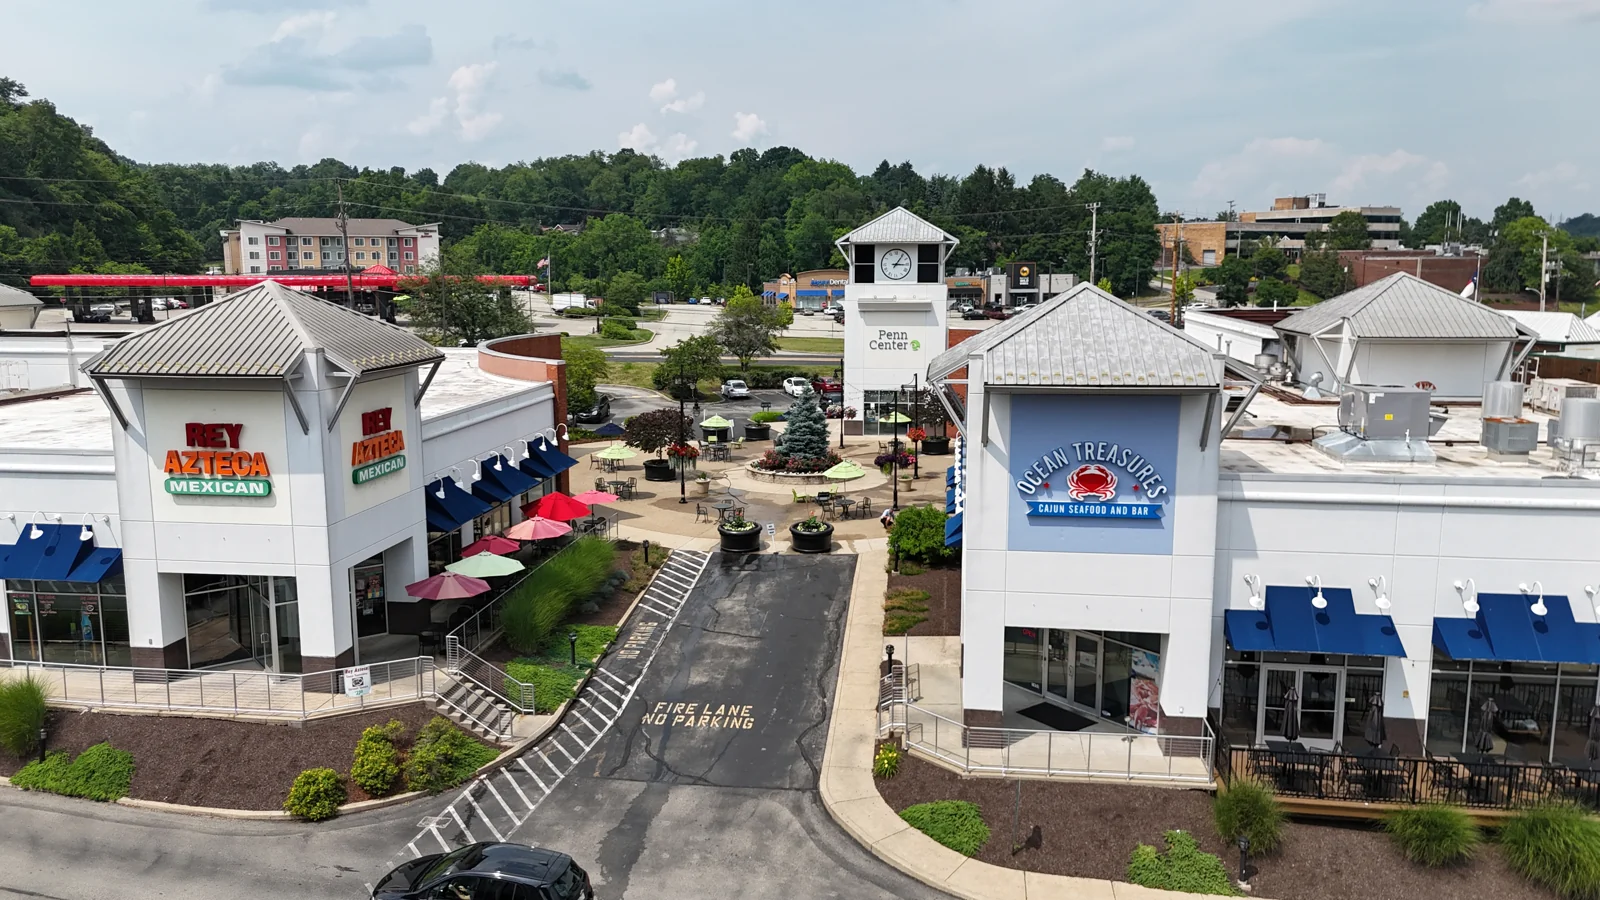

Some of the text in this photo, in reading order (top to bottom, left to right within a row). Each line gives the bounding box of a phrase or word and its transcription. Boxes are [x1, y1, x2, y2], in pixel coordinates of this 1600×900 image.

[878, 330, 908, 340] Penn
[869, 340, 908, 350] Center
[362, 406, 392, 436] REY
[185, 422, 244, 449] REY
[351, 429, 405, 466] AZTECA
[163, 449, 270, 477] AZTECA
[358, 456, 404, 482] MEXICAN
[1016, 441, 1168, 498] OCEAN TREASURES
[169, 480, 265, 494] MEXICAN
[1038, 504, 1149, 516] CAJUN SEAFOOD AND BAR
[1022, 628, 1036, 638] OPEN
[654, 702, 753, 717] FIRE LANE
[641, 712, 755, 730] NO PARKING
